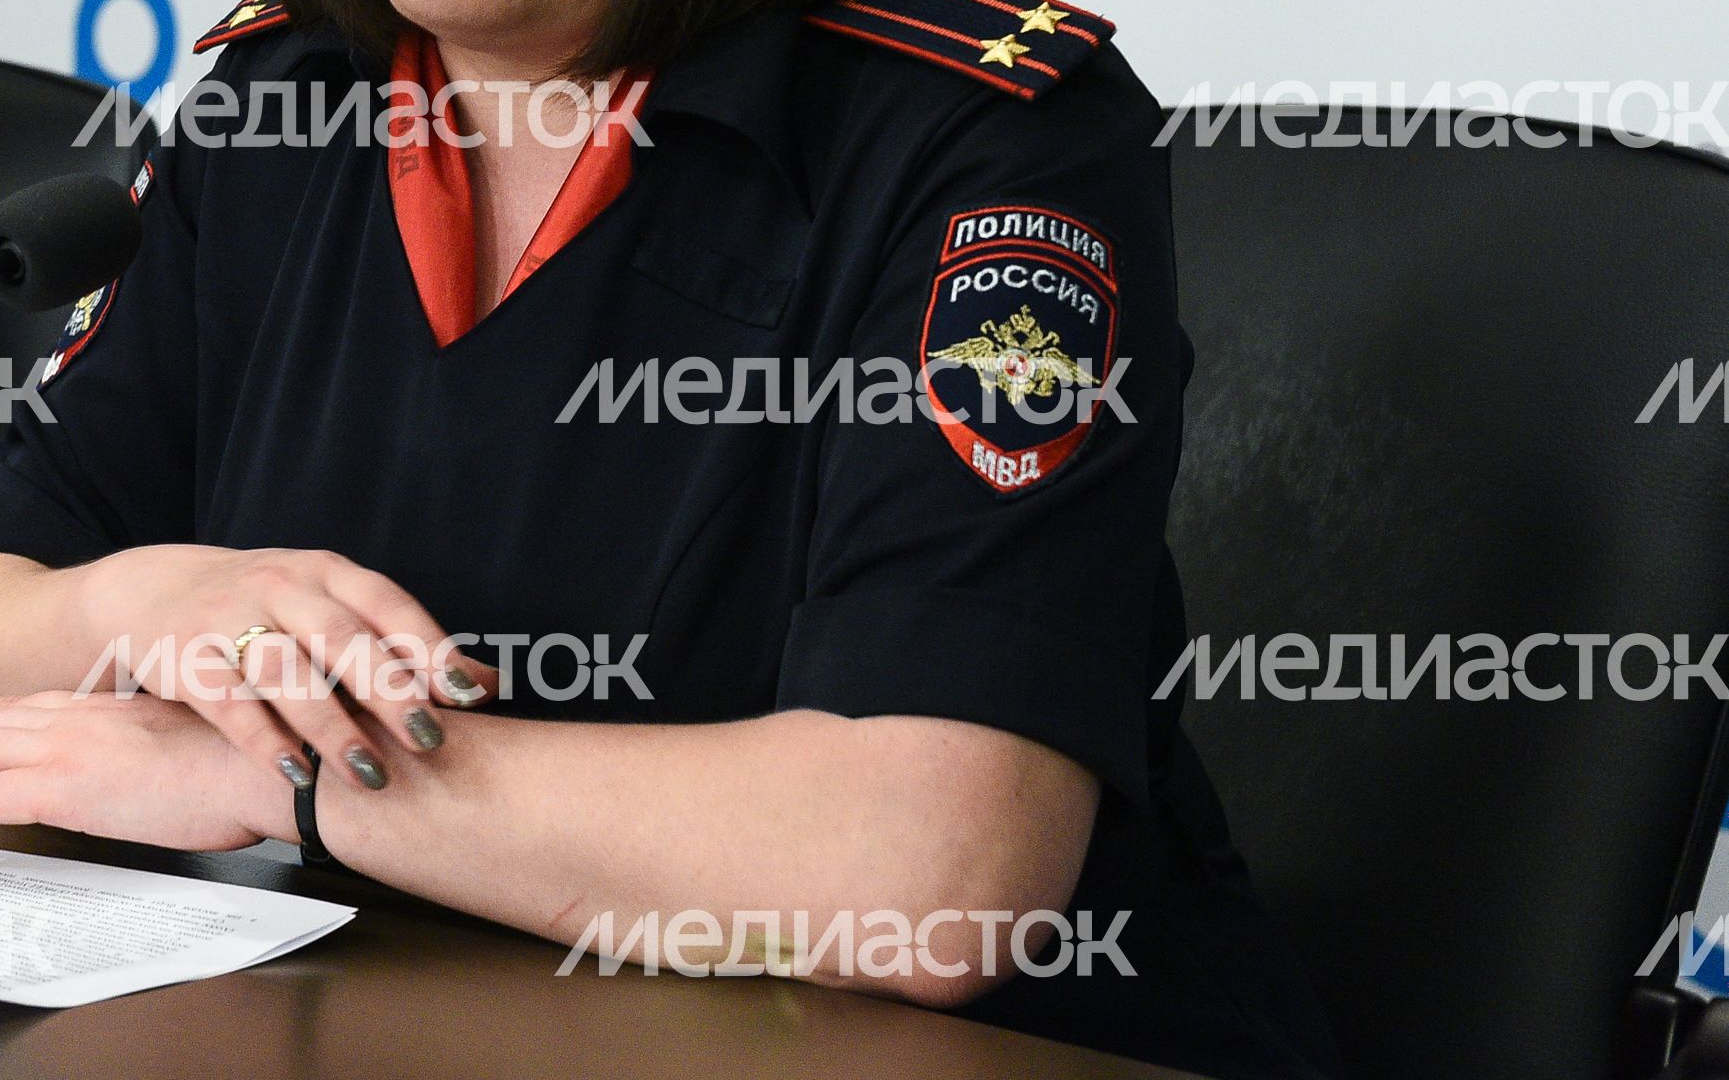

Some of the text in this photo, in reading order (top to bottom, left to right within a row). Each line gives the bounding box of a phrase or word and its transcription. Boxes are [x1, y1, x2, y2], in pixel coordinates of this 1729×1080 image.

[954, 212, 1107, 270] ПОЛИЦИЯ
[949, 264, 1100, 325] РОССИЯ
[971, 440, 1041, 488] МВД
